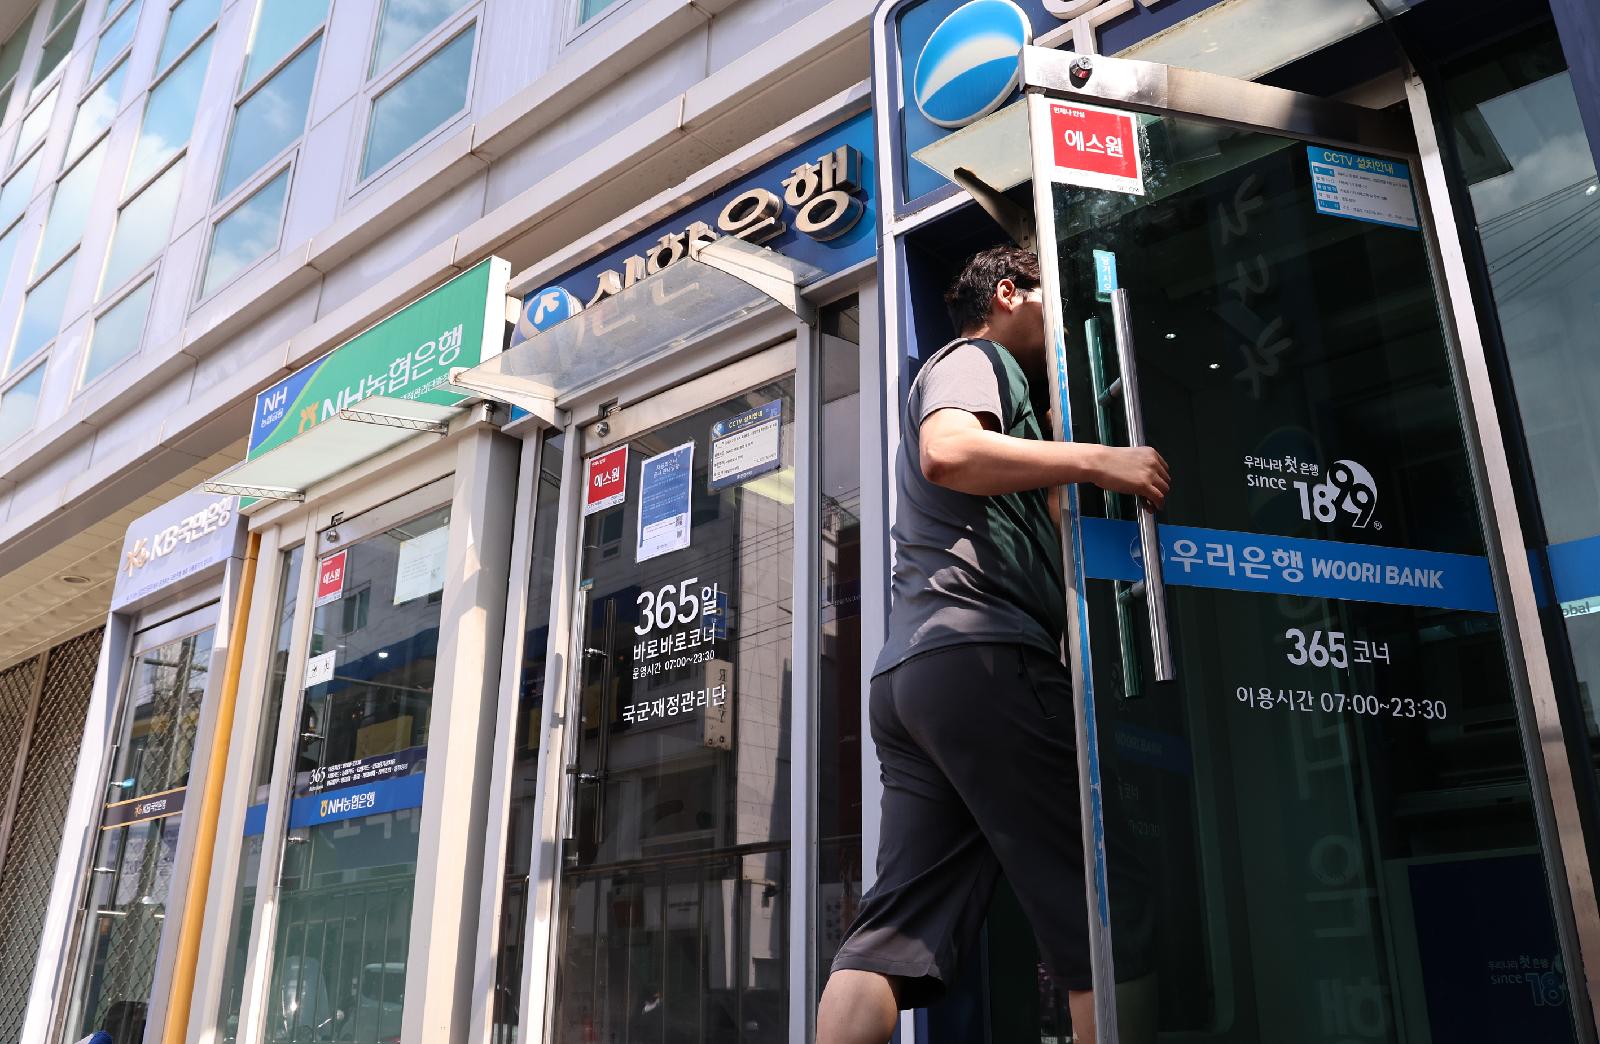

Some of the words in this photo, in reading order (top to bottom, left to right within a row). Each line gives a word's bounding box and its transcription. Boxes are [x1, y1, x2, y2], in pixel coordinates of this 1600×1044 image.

[1064, 129, 1124, 158] 에스원
[1324, 151, 1353, 166] CCTV
[263, 386, 288, 416] NH
[593, 466, 621, 488] 에스원
[1243, 455, 1283, 472] 우리나라
[1284, 455, 1298, 474] 첫
[1299, 462, 1320, 477] 은행
[1293, 459, 1378, 529] 1899
[149, 497, 233, 561] KB국민은행
[1170, 539, 1304, 583] 우리은행
[1311, 558, 1381, 584] WOORI
[1385, 565, 1445, 590] BANK
[633, 577, 718, 636] 365일
[633, 622, 716, 662] 바로바로코너
[1285, 628, 1350, 669] 365
[1353, 640, 1391, 665] 코너
[632, 663, 662, 680] 운영시간
[664, 649, 715, 671] 07:00~23:30
[622, 684, 727, 725] 국군재정관리단
[1236, 686, 1314, 713] 이용시간
[1320, 693, 1448, 721] 07:00~23:30
[309, 767, 327, 785] 365
[327, 792, 376, 815] NH농협은행
